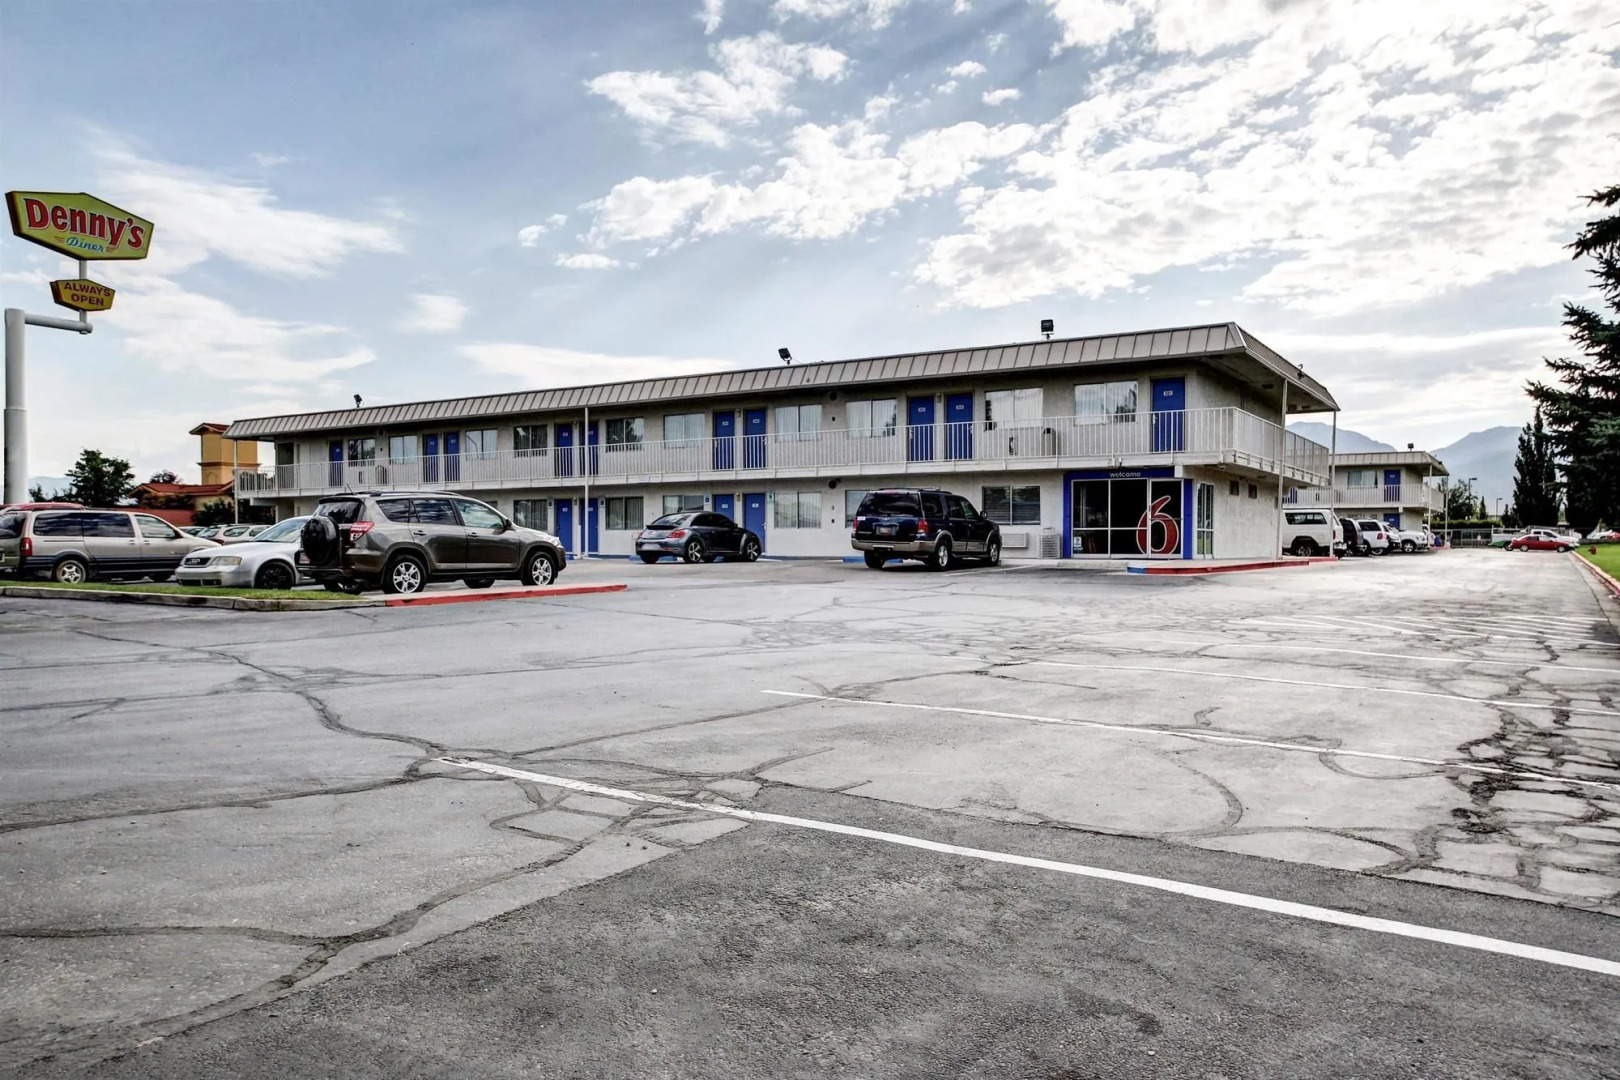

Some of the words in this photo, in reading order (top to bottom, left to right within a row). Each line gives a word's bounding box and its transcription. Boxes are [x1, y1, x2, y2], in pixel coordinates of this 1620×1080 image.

[23, 197, 146, 249] Denny's
[66, 236, 104, 253] Diner
[64, 282, 111, 297] ALWAYS
[71, 293, 104, 306] OPEN
[1136, 495, 1179, 555] 6
